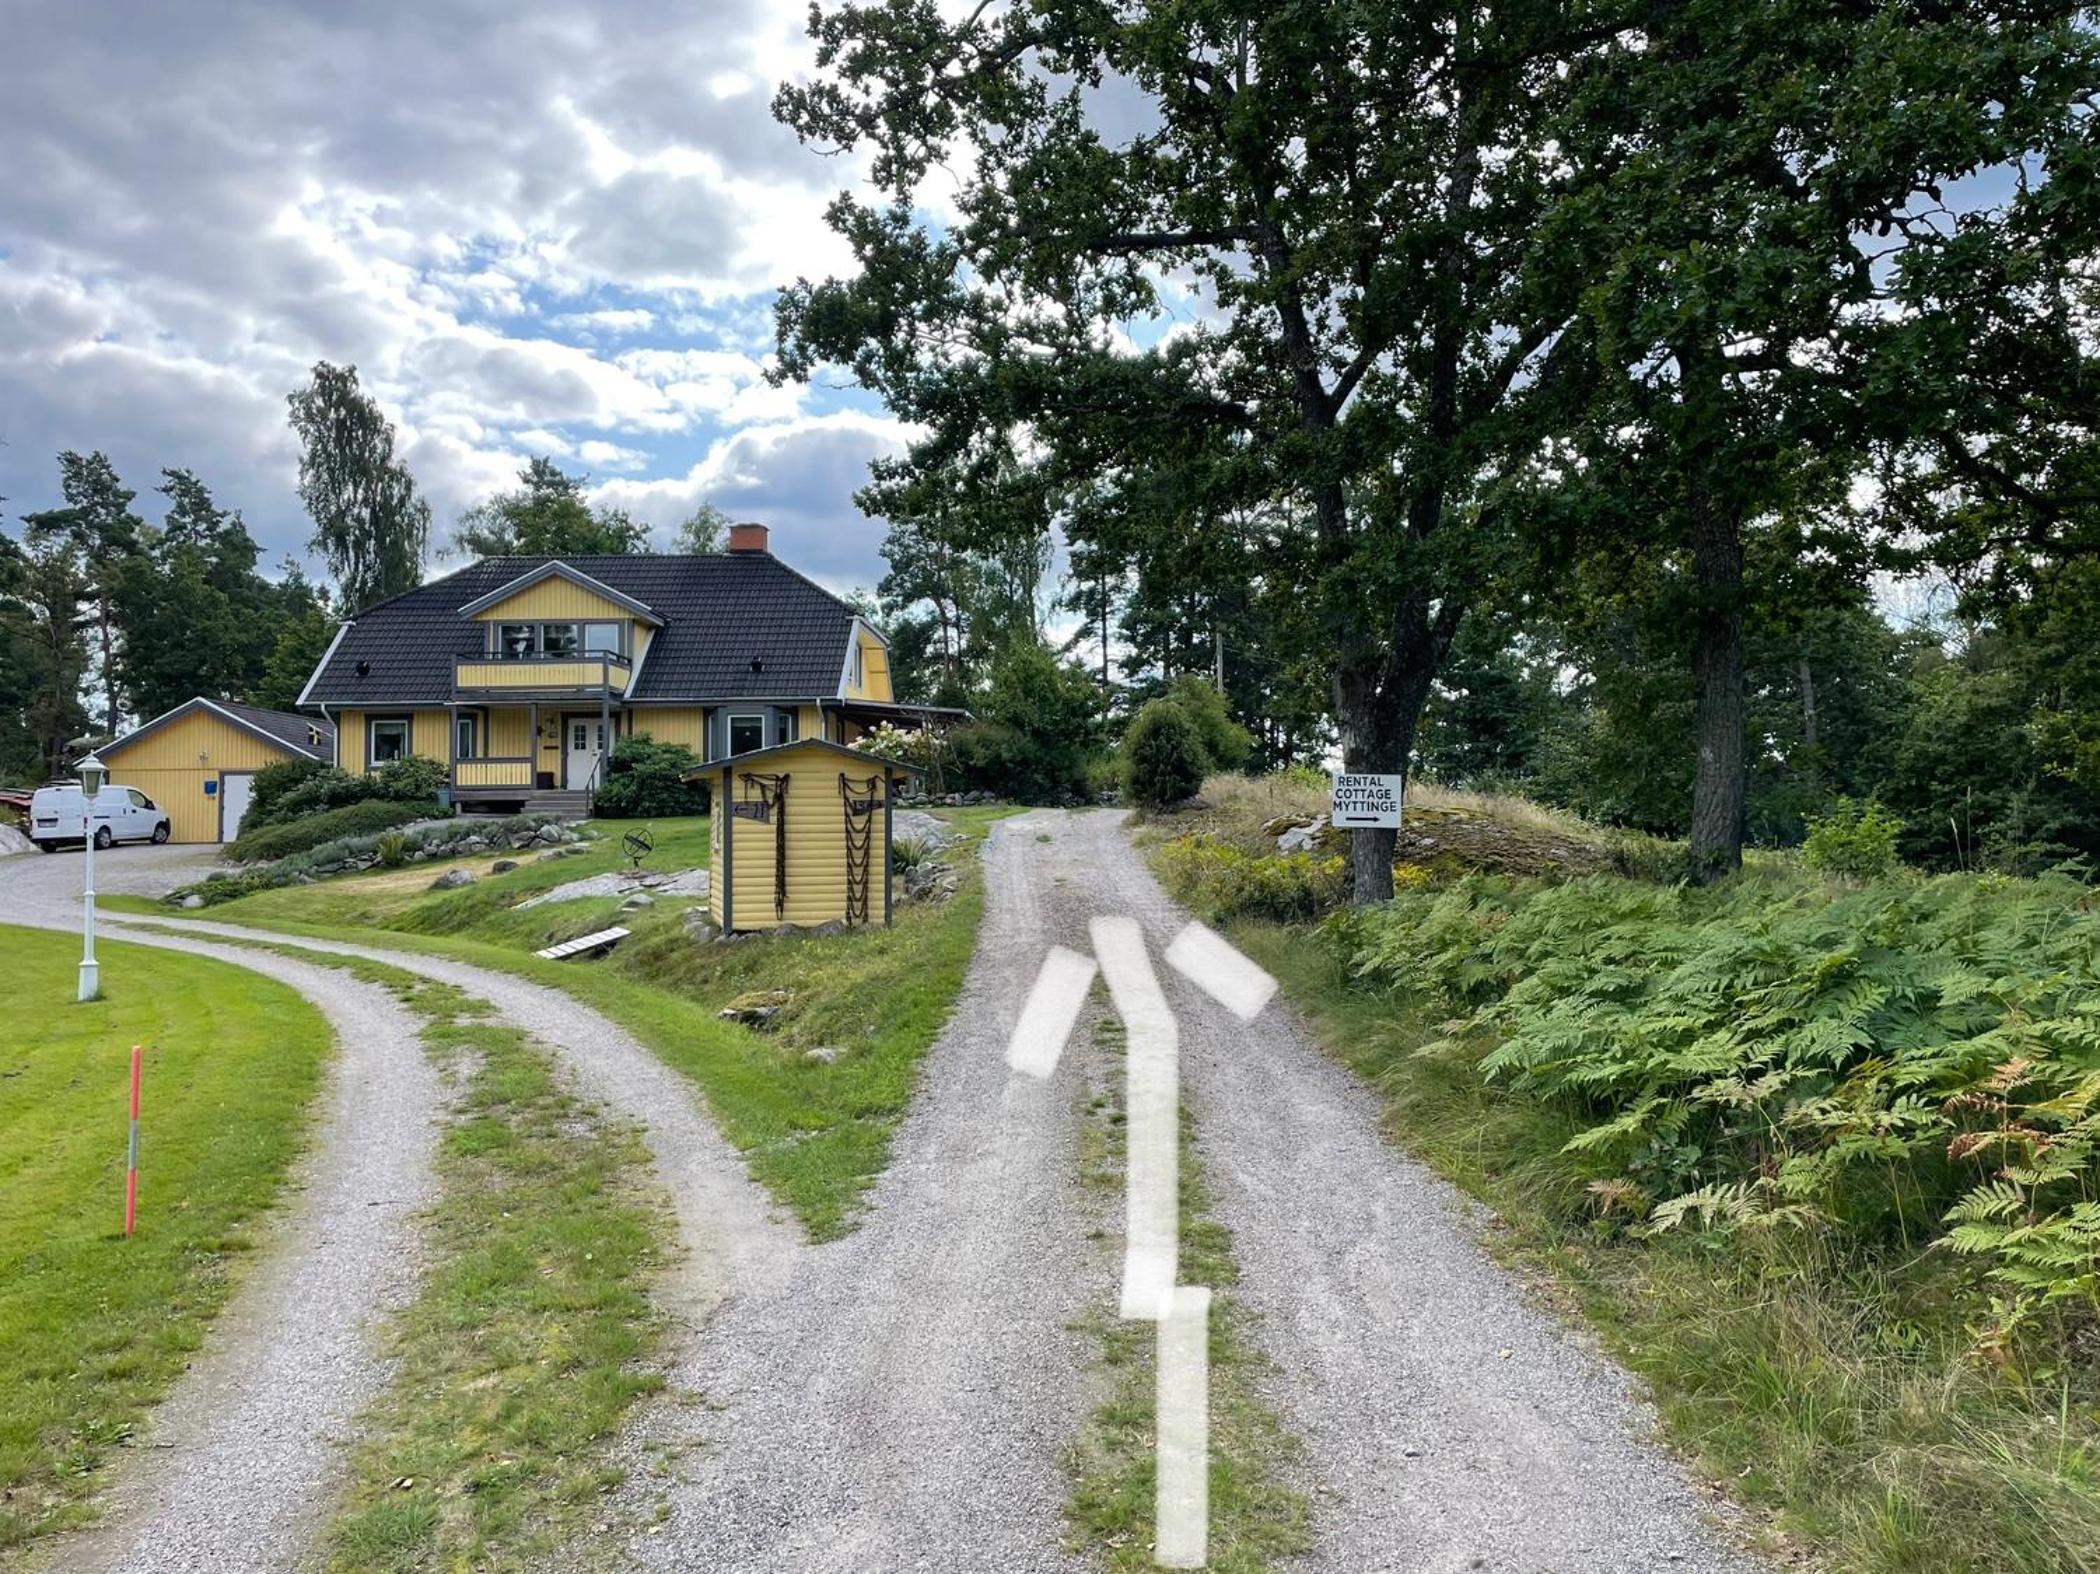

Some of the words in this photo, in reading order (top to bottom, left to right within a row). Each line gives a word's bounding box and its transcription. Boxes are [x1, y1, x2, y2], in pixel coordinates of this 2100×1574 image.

[1338, 776, 1384, 787] RENTAL
[1335, 788, 1392, 799] COTTAGE
[1333, 800, 1397, 812] MYTTINGE
